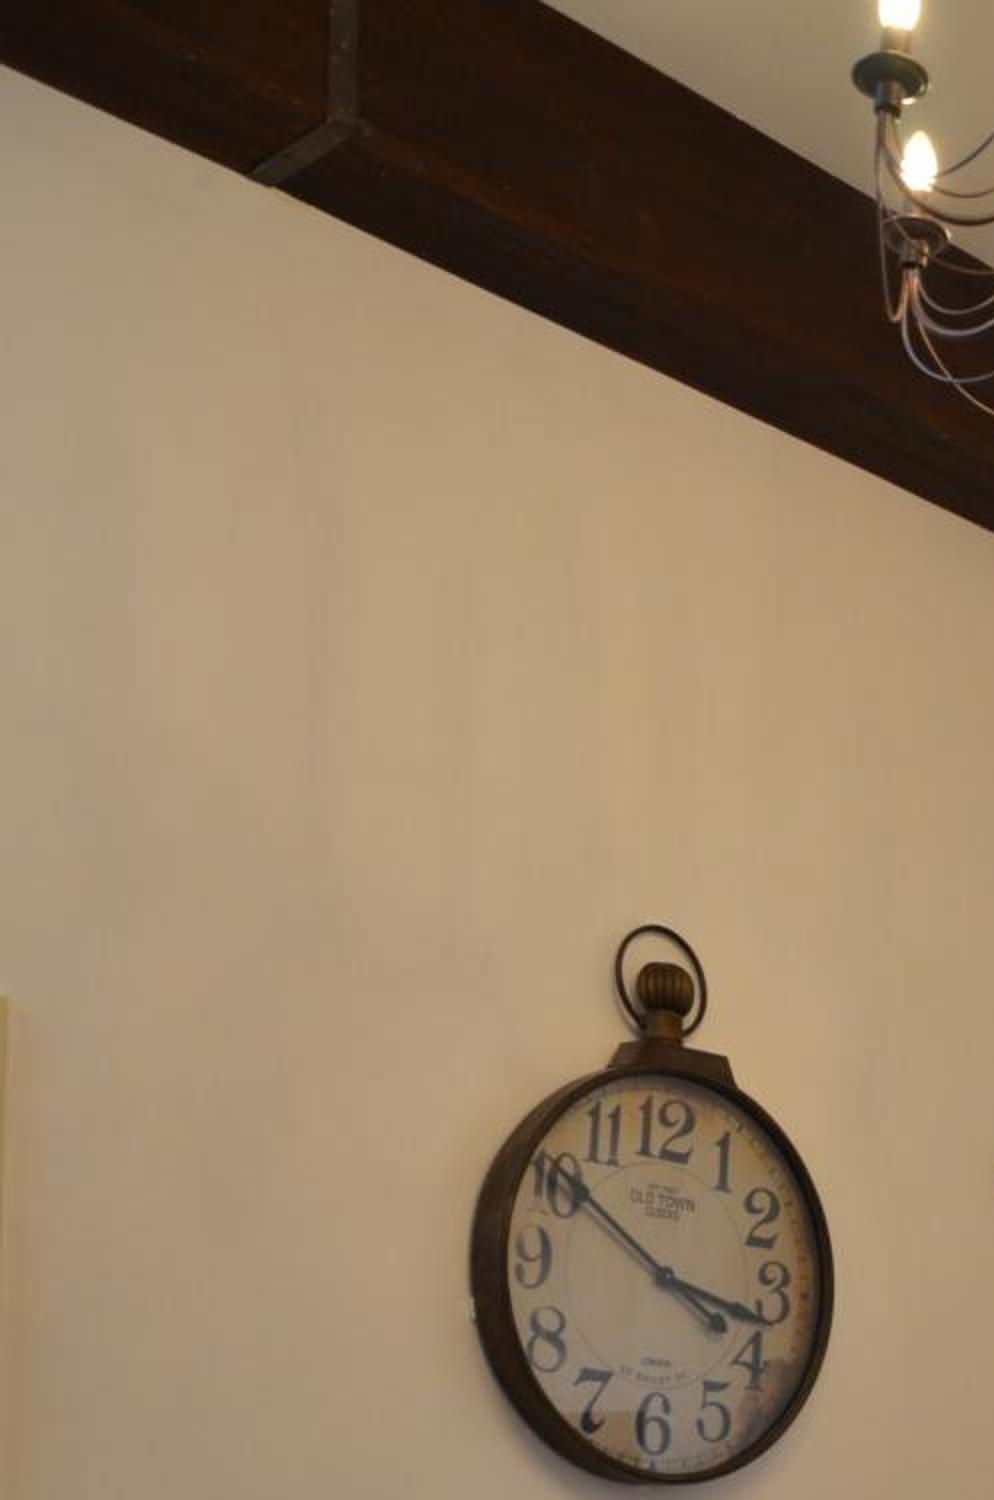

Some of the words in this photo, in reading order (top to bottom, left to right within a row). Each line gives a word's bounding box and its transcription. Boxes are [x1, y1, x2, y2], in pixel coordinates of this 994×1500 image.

[584, 1100, 622, 1166] 11
[636, 1095, 696, 1164] 12
[713, 1131, 732, 1192] 1
[532, 1150, 582, 1219] 10
[744, 1187, 781, 1249] 2
[515, 1225, 552, 1288] 9
[756, 1261, 791, 1326] 3
[527, 1305, 566, 1373] 8
[732, 1330, 767, 1391] 4
[574, 1367, 613, 1434] 7
[635, 1391, 671, 1456] 6
[697, 1380, 732, 1442] 5
